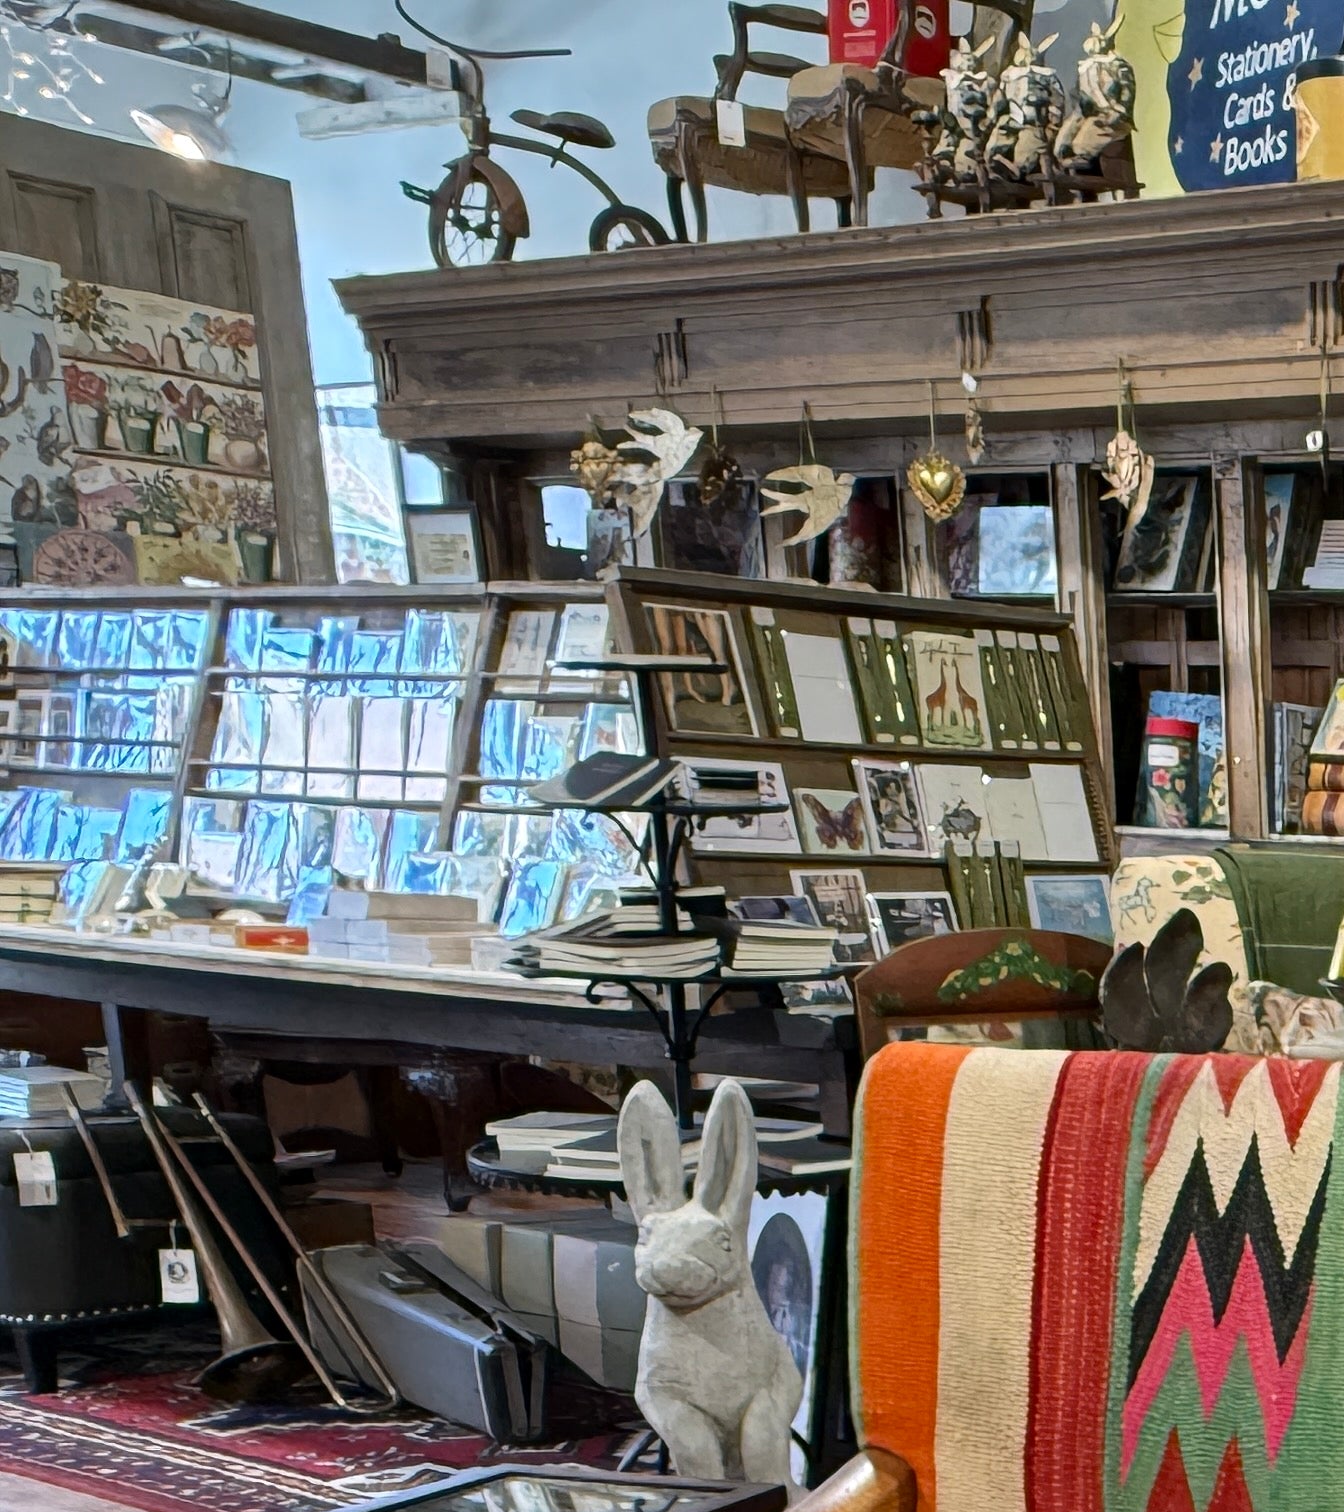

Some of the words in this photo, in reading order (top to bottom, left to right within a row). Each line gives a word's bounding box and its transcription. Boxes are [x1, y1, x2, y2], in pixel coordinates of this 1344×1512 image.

[1215, 28, 1318, 88] Stationery,
[1224, 83, 1275, 129] Cards
[1282, 73, 1297, 111] &
[1224, 124, 1288, 176] Books
